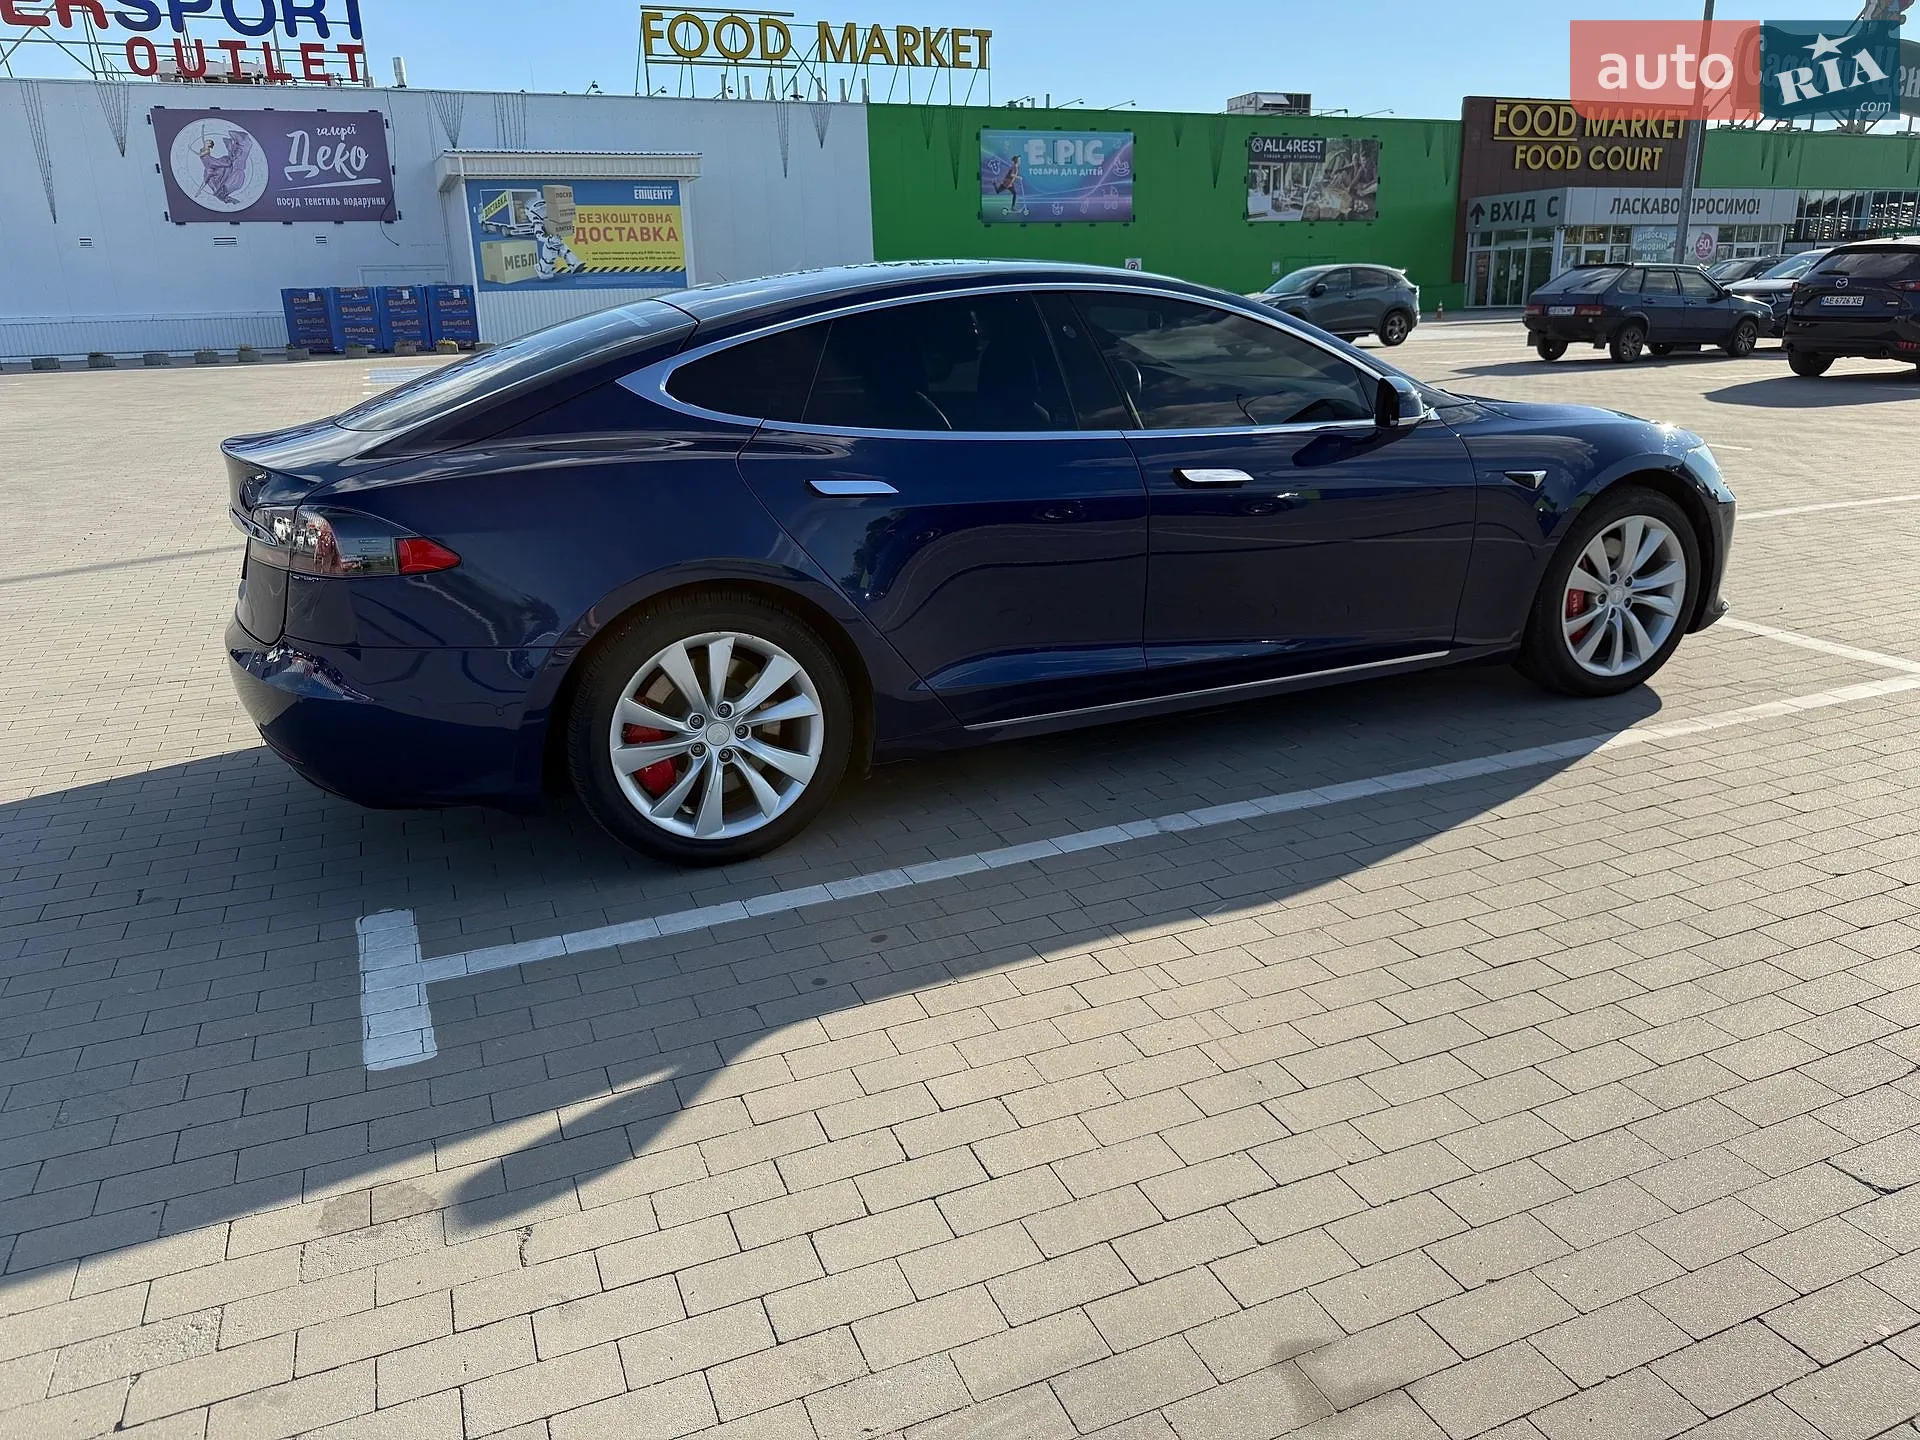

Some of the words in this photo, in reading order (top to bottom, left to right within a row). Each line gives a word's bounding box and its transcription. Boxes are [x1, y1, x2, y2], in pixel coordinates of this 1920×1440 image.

[642, 12, 792, 60] FOOD
[817, 21, 992, 69] MARKET
[126, 36, 364, 82] OUTLET
[1494, 104, 1577, 136] FOOD
[1585, 107, 1689, 139] MARKET
[316, 124, 357, 140] галереї
[284, 130, 369, 181] Деко
[1264, 139, 1323, 153] ALL4REST
[1515, 145, 1582, 170] FOOD
[1589, 146, 1664, 171] COURT
[1061, 168, 1077, 176] ДЛЯ
[1080, 167, 1103, 176] ДІТЕЙ
[277, 197, 301, 207] посуд
[304, 197, 341, 206] текстиль
[344, 197, 386, 208] подарунки
[634, 189, 673, 200] ЕПІЦЕНТР
[1490, 200, 1537, 223] ВХІД
[1610, 198, 1680, 215] ЛАСКАВО
[579, 213, 673, 224] БЕЗКОШТОВНА
[574, 226, 679, 245] ДОСТАВКА
[504, 252, 538, 271] МЕБЛІ
